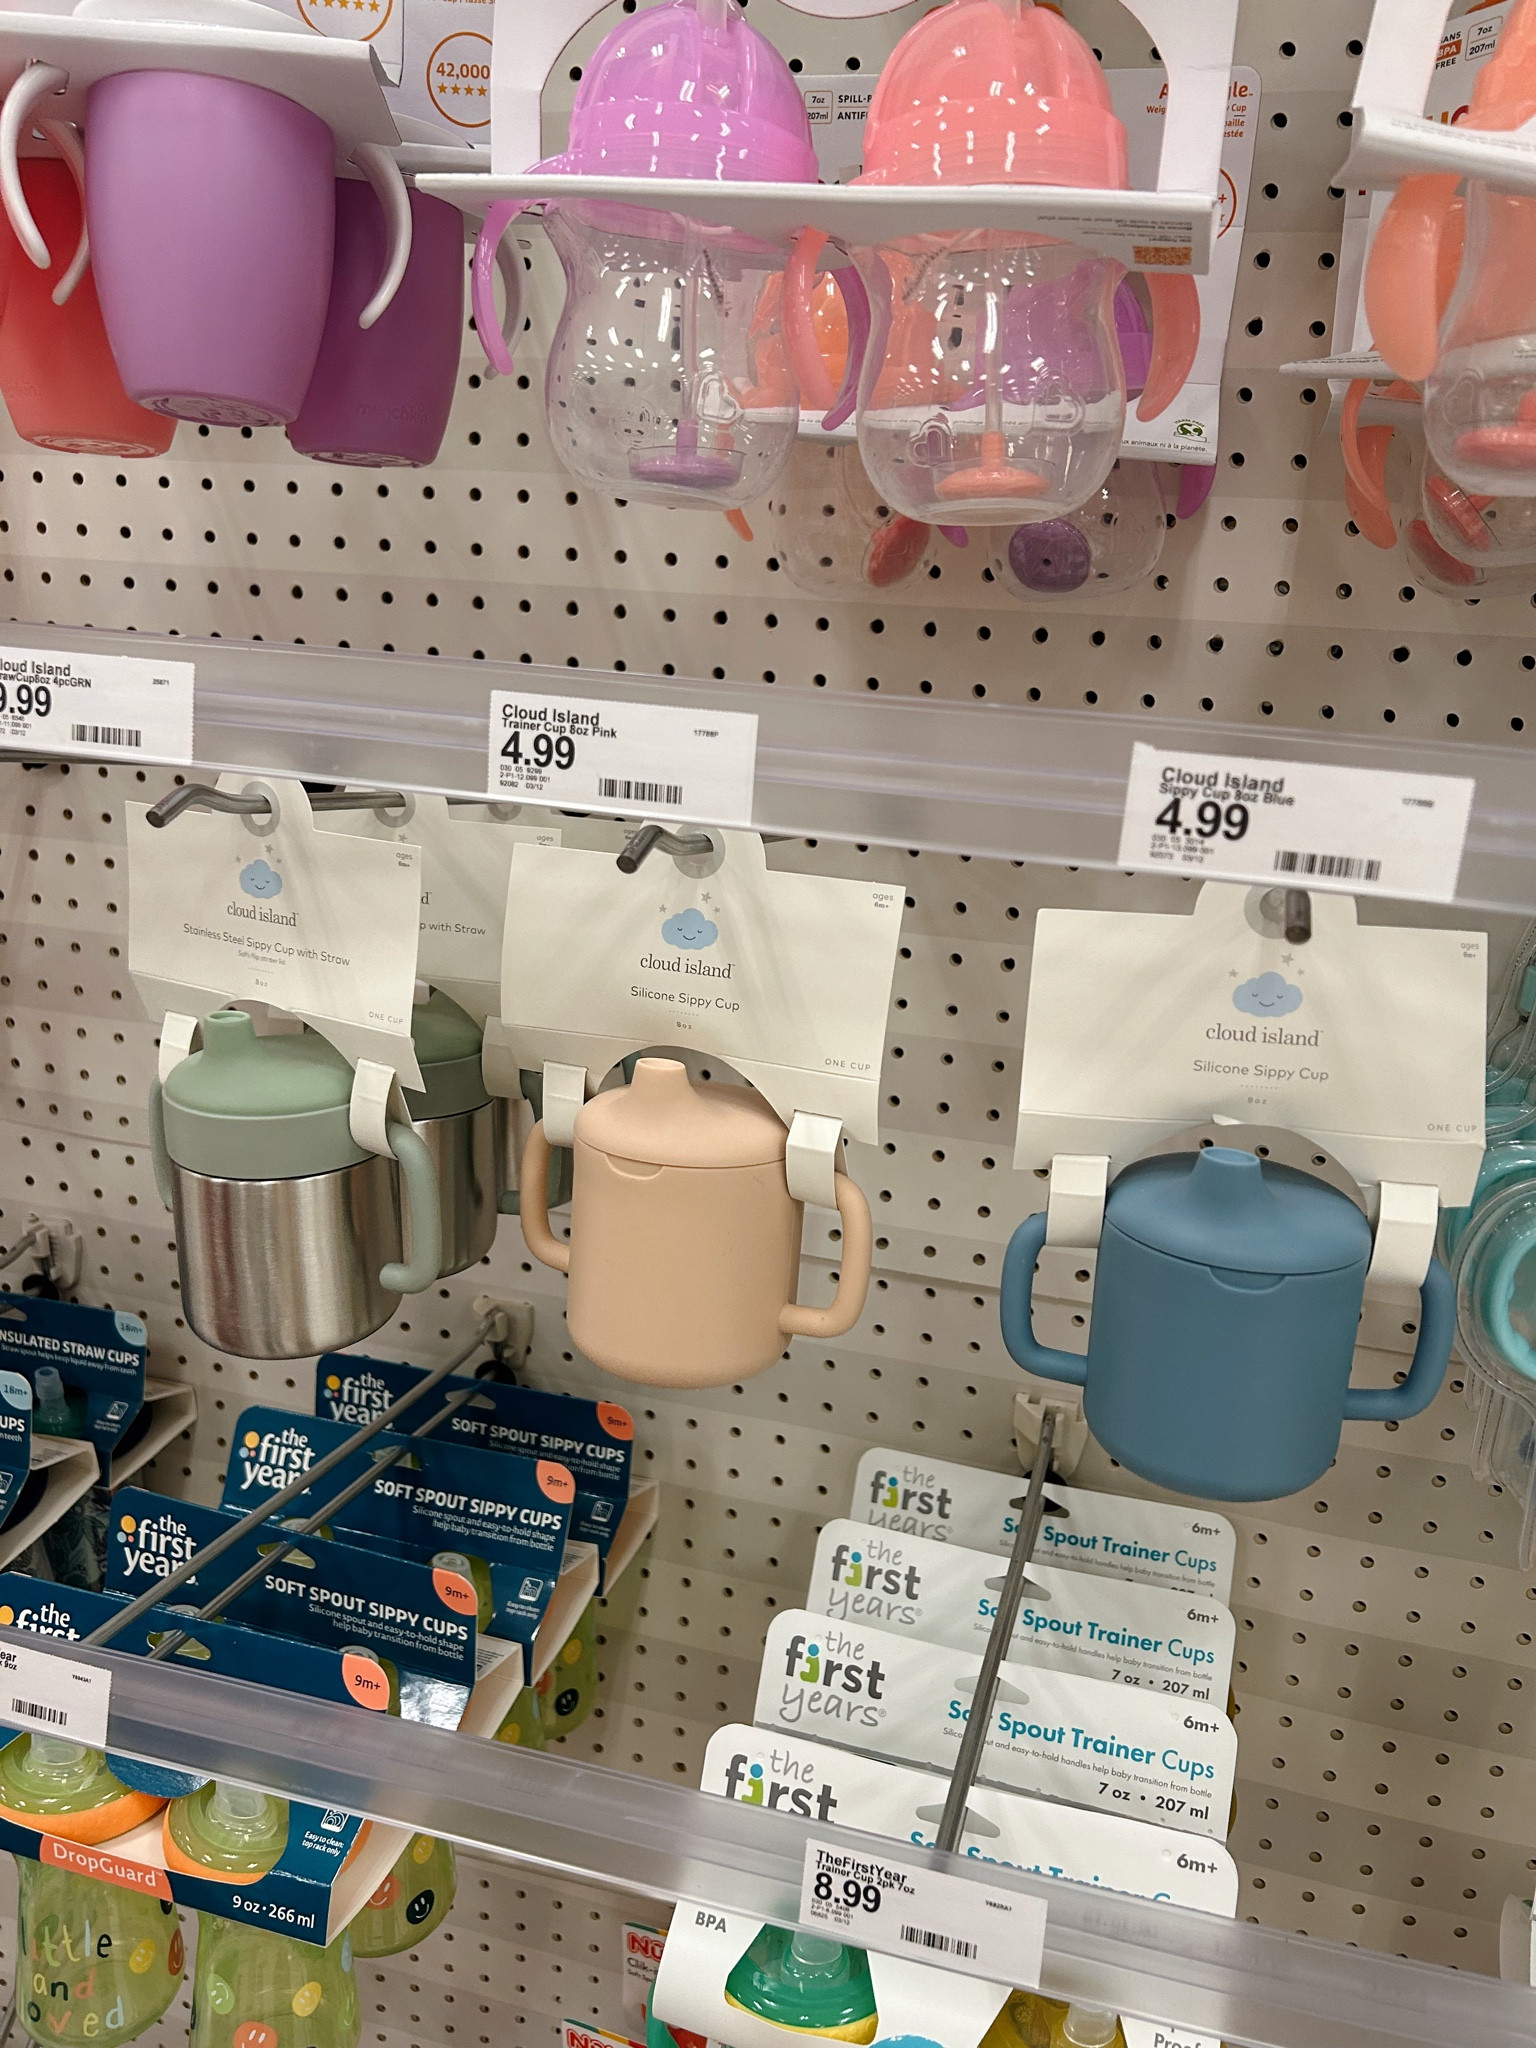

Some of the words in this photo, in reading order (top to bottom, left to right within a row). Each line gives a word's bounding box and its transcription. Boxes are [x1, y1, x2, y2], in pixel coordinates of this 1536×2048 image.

[1477, 25, 1493, 36] 7oz
[1469, 40, 1496, 55] 207ml
[435, 62, 491, 80] 42,000
[1435, 57, 1457, 70] FREE
[811, 95, 825, 104] 7oz
[31, 661, 72, 677] Island
[53, 679, 92, 688] 4pcGRN
[502, 703, 548, 721] Cloud
[552, 708, 600, 727] Island
[502, 717, 541, 731] Trainer
[544, 722, 567, 736] Cup
[570, 725, 589, 736] 8oz
[592, 727, 617, 739] Pink
[501, 730, 575, 770] 4.99
[1161, 766, 1219, 788] Cloud
[1224, 769, 1284, 793] Island
[1159, 782, 1198, 799] Sippy
[1202, 786, 1230, 801] Cup
[1234, 788, 1258, 803] 8oz
[1263, 791, 1295, 806] Blue
[1154, 797, 1250, 840] 4.99
[872, 892, 894, 901] ages
[226, 901, 257, 920] cloud
[259, 906, 297, 927] island
[428, 922, 452, 932] with
[454, 923, 487, 935] Straw
[183, 923, 222, 941] Stainless
[222, 931, 245, 946] Steel
[246, 937, 272, 954] Sippy
[274, 942, 295, 956] Cup
[297, 947, 319, 960] with
[320, 951, 351, 967] Straw
[1460, 941, 1480, 952] ages
[640, 953, 681, 973] cloud
[684, 958, 732, 980] island
[630, 985, 675, 1002] Silicone
[678, 992, 712, 1010] Sippy
[715, 997, 741, 1013] Cup
[368, 1011, 385, 1021] ONE
[387, 1015, 404, 1025] CUP
[1205, 1022, 1257, 1043] cloud
[1261, 1026, 1320, 1047] island
[824, 1057, 847, 1068] ONE
[850, 1061, 871, 1071] CUP
[1193, 1059, 1249, 1076] Silicone
[1253, 1064, 1296, 1081] Sippy
[1299, 1067, 1330, 1083] Cup
[1427, 1122, 1450, 1133] ONE
[1455, 1123, 1478, 1134] CUP
[0, 1328, 60, 1351] NSULATED
[62, 1340, 105, 1361] STRAW
[107, 1348, 140, 1368] CUPS
[3, 1384, 29, 1397] 18m+
[342, 1377, 395, 1410] first
[360, 1372, 386, 1391] the
[606, 1415, 628, 1428] 9m+
[282, 1427, 309, 1448] the
[452, 1417, 488, 1435] SOFT
[489, 1425, 539, 1446] SPOUT
[540, 1434, 585, 1455] SIPPY
[586, 1444, 627, 1463] CUPS
[259, 1432, 316, 1471] first
[546, 1475, 569, 1488] 9m+
[902, 1465, 936, 1489] the
[374, 1479, 413, 1499] SOFT
[415, 1487, 468, 1513] SPOUT
[470, 1498, 518, 1521] SIPPY
[519, 1508, 563, 1530] CUPS
[870, 1470, 952, 1519] first
[159, 1514, 187, 1536] the
[1191, 1522, 1222, 1537] 6m+
[138, 1518, 197, 1560] first
[1043, 1525, 1099, 1551] Spout
[1102, 1536, 1171, 1563] Trainer
[1174, 1550, 1218, 1575] Cups
[867, 1539, 903, 1566] the
[831, 1544, 922, 1600] first
[445, 1586, 469, 1600] 9m+
[40, 1602, 71, 1628] the
[265, 1574, 306, 1598] SOFT
[309, 1586, 365, 1613] SPOUT
[369, 1601, 419, 1627] SIPPY
[422, 1616, 468, 1641] CUPS
[1187, 1608, 1220, 1624] 6m+
[308, 1603, 341, 1619] Silicone
[341, 1612, 367, 1625] spout
[367, 1618, 384, 1630] and
[384, 1623, 438, 1645] easy-to-hold
[438, 1637, 465, 1652] shape
[332, 1618, 352, 1632] help
[352, 1623, 373, 1639] baby
[373, 1630, 415, 1648] transition
[415, 1640, 438, 1653] from
[438, 1644, 465, 1661] bottle
[1022, 1608, 1083, 1637] Spout
[1087, 1621, 1163, 1653] Trainer
[1167, 1638, 1215, 1667] Cups
[825, 1630, 865, 1661] the
[1034, 1638, 1077, 1653] easy-to-hold
[1078, 1646, 1105, 1659] handles
[1106, 1652, 1122, 1664] help
[1123, 1655, 1142, 1668] baby
[1143, 1661, 1174, 1674] transition
[785, 1634, 886, 1700] first
[355, 1674, 381, 1691] 9m+
[1111, 1669, 1121, 1681] 7
[1123, 1674, 1141, 1686] oz
[1161, 1679, 1190, 1696] 207
[1192, 1687, 1210, 1701] ml
[1183, 1714, 1220, 1733] 6m+
[997, 1712, 1066, 1743] Spout
[1071, 1727, 1156, 1765] Trainer
[1161, 1749, 1215, 1781] Cups
[769, 1749, 815, 1784] the
[994, 1742, 1011, 1751] and
[1011, 1744, 1060, 1762] easy-to-hold
[1060, 1755, 1091, 1770] handles
[1092, 1764, 1110, 1776] help
[1111, 1768, 1132, 1781] baby
[1133, 1773, 1169, 1788] transition
[1170, 1780, 1188, 1793] from
[1190, 1784, 1213, 1798] bottle
[725, 1753, 838, 1824] first
[1098, 1781, 1109, 1795] 7
[1112, 1788, 1131, 1802] oz
[1154, 1795, 1187, 1814] 207
[1190, 1805, 1210, 1821] ml
[304, 1830, 320, 1842] Easy
[313, 1842, 327, 1852] rack
[326, 1847, 341, 1858] only
[1176, 1852, 1219, 1874] 6m+
[815, 1860, 852, 1879] Trainer
[853, 1870, 874, 1886] Cup
[876, 1876, 896, 1890] 2pk
[896, 1882, 916, 1895] 7oz
[816, 1849, 908, 1884] TheFirstYear
[813, 1871, 882, 1913] 8.99
[232, 1895, 241, 1909] 9
[243, 1900, 259, 1914] oz
[268, 1903, 295, 1923] 266
[296, 1911, 316, 1929] ml
[695, 1910, 727, 1933] BPA
[33, 1967, 96, 2001] and
[28, 1994, 125, 2038] oved
